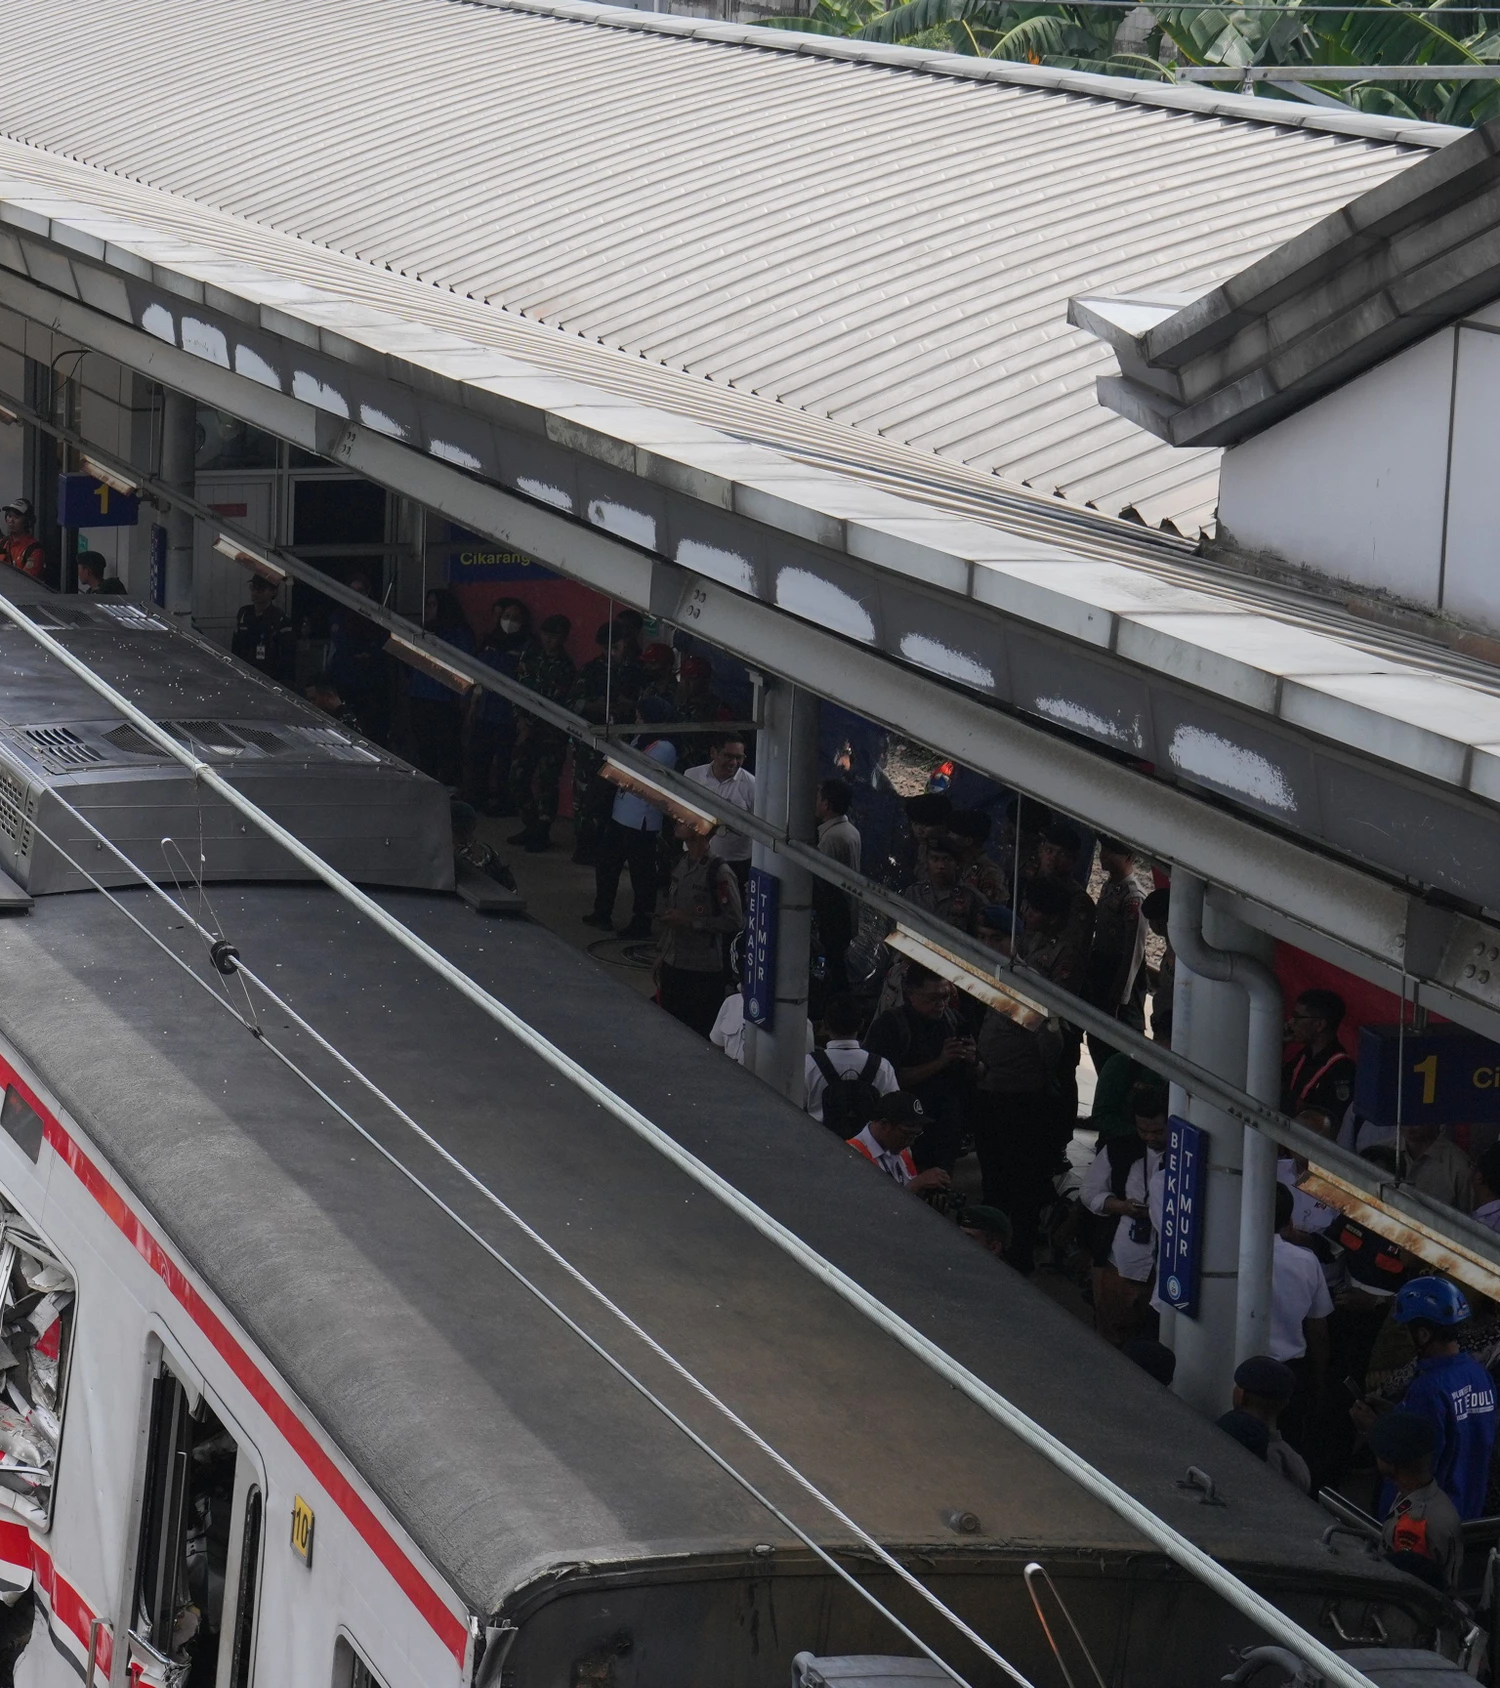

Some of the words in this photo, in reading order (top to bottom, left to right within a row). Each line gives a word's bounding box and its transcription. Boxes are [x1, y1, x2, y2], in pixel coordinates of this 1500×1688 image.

[94, 483, 110, 515] 1
[460, 552, 531, 566] Cikarang
[748, 880, 756, 984] BEKASI
[758, 893, 767, 981] TIMUR
[1413, 1055, 1437, 1104] 1
[1165, 1132, 1178, 1258] BEKASI
[1180, 1151, 1193, 1257] TIMUR
[297, 1508, 308, 1548] 10
